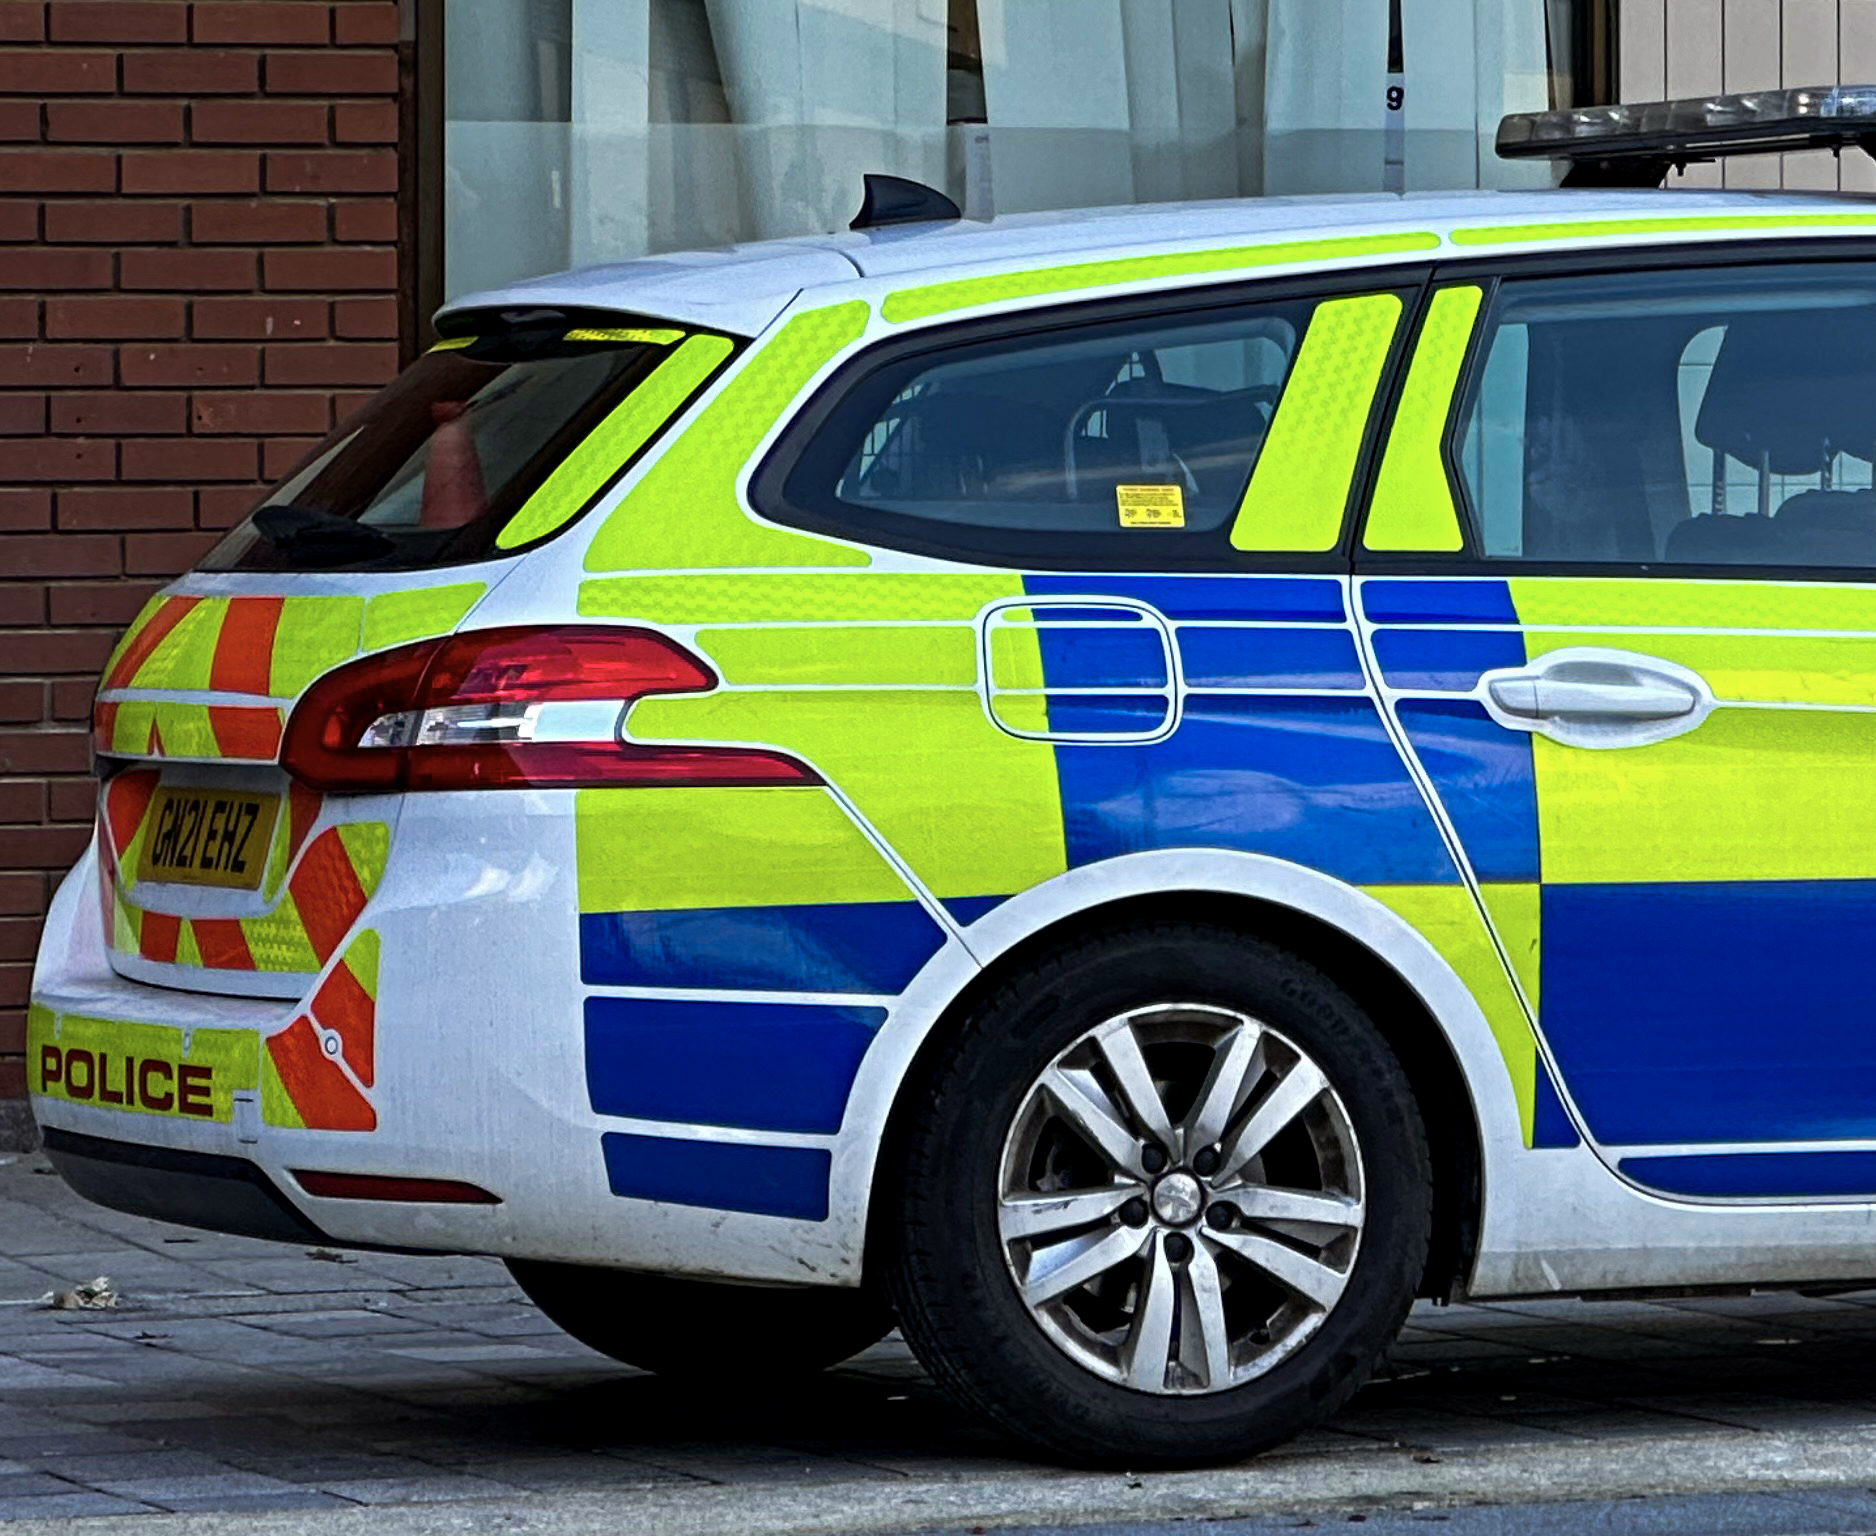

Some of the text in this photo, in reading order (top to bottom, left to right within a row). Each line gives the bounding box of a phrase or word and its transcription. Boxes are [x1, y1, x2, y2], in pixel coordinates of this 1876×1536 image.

[1386, 85, 1405, 111] 9
[152, 798, 260, 874] GN21 EHZ
[42, 1043, 213, 1117] POLICE
